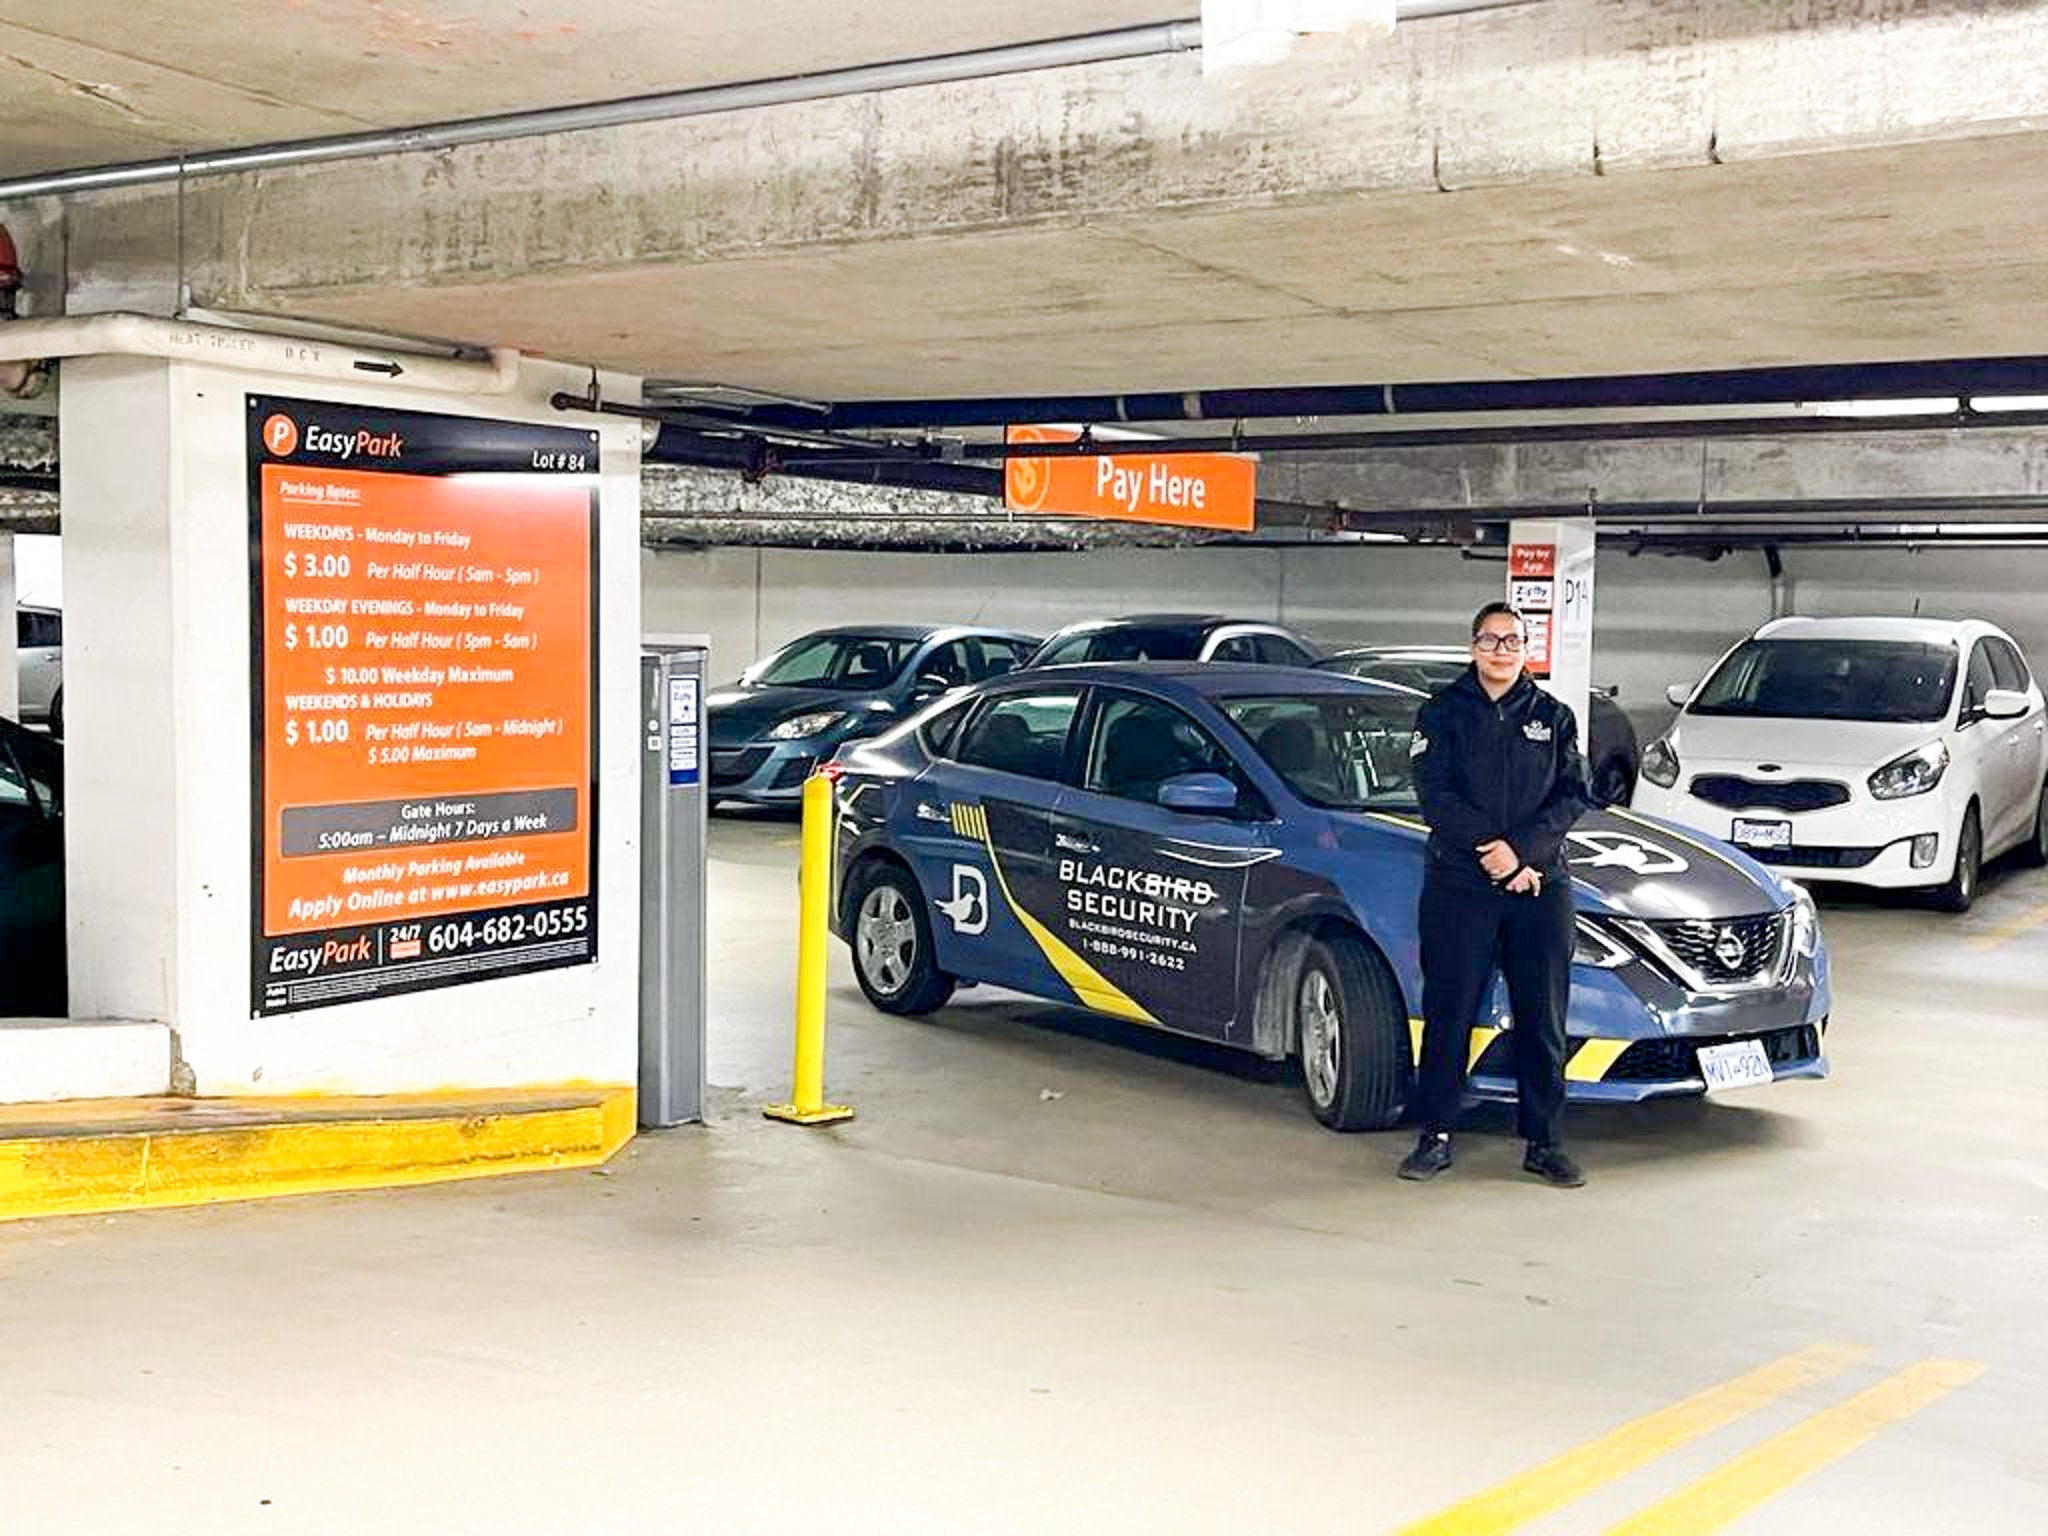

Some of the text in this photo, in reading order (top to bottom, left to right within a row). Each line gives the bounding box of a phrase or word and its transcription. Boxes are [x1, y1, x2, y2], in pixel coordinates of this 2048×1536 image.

[305, 425, 403, 459] EasyPark
[533, 450, 555, 469] Lot
[568, 453, 585, 470] 84
[1097, 455, 1206, 512] Pay Here
[284, 522, 354, 541] WEEKDAYS
[365, 528, 415, 548] Monday
[419, 531, 432, 545] to
[434, 531, 471, 550] Friday
[284, 550, 297, 580] $
[304, 553, 351, 577] 3.00
[368, 561, 389, 579] Per
[392, 563, 421, 580] Half
[423, 565, 455, 581] Hour
[285, 598, 348, 614] WEEKDAY
[351, 599, 414, 615] EVENINGS
[424, 601, 472, 620] Monday
[474, 603, 487, 616] to
[489, 602, 524, 621] Friday
[285, 622, 298, 651] $
[306, 625, 349, 648] 1.00
[366, 631, 388, 648] Per
[391, 631, 419, 649] Half
[421, 632, 453, 649] Hour
[325, 666, 514, 687] $ 10.00 Weekday Maximum
[285, 693, 358, 710] WEEKENDS
[373, 692, 433, 708] HOLIDAYS
[286, 719, 298, 746] $
[306, 719, 349, 743] 1.00
[366, 723, 388, 740] Per
[390, 722, 420, 740] Half
[421, 722, 454, 739] Hour
[502, 717, 556, 738] Midnight
[368, 744, 477, 764] $ 5.00 Maximum
[401, 802, 475, 819] Gate Hours:
[318, 831, 374, 849] 5:00am
[389, 822, 451, 842] Midnight
[455, 821, 465, 837] 7
[467, 820, 500, 838] Days
[502, 821, 511, 832] a
[514, 813, 548, 831] Week
[343, 851, 525, 885] Monthly Parking Available
[1059, 859, 1214, 905] BLACKBIRD
[289, 871, 569, 921] Apply Online at www.easypark.ca
[1067, 889, 1198, 933] SECURITY
[269, 935, 372, 974] EasyPark
[390, 924, 421, 943] 24/7
[429, 905, 588, 953] 604-682-0555
[1083, 938, 1185, 971] 1-888-991-2622
